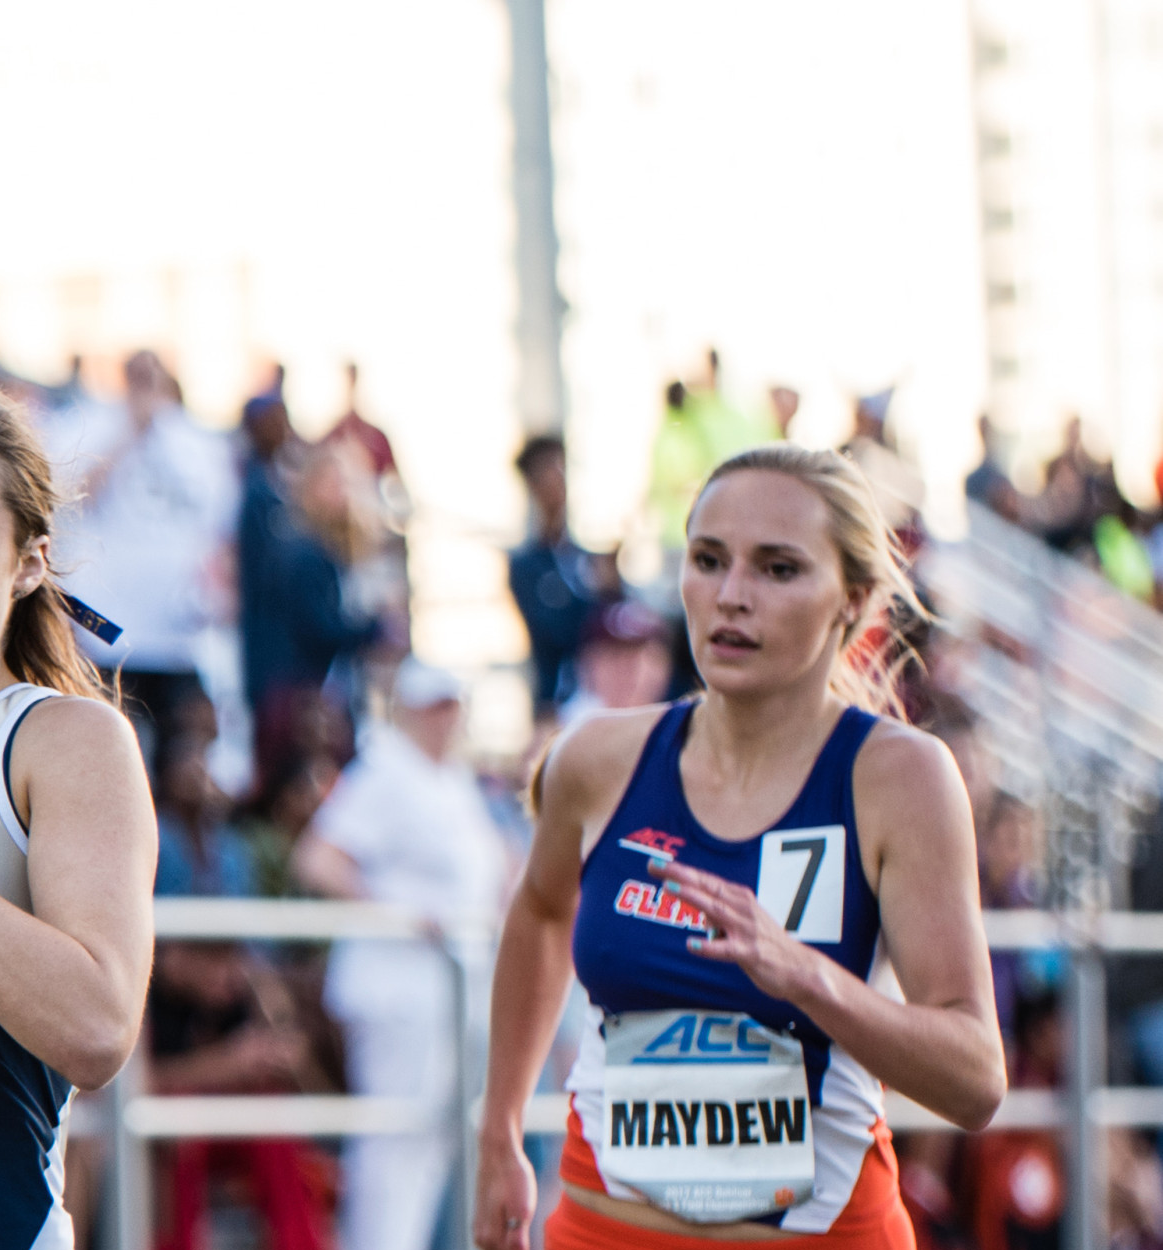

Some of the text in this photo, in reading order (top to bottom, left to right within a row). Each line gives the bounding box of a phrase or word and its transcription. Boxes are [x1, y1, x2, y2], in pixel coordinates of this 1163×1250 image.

[781, 836, 827, 932] 7
[645, 1014, 771, 1054] ACC
[610, 1098, 806, 1147] MAYDEW
